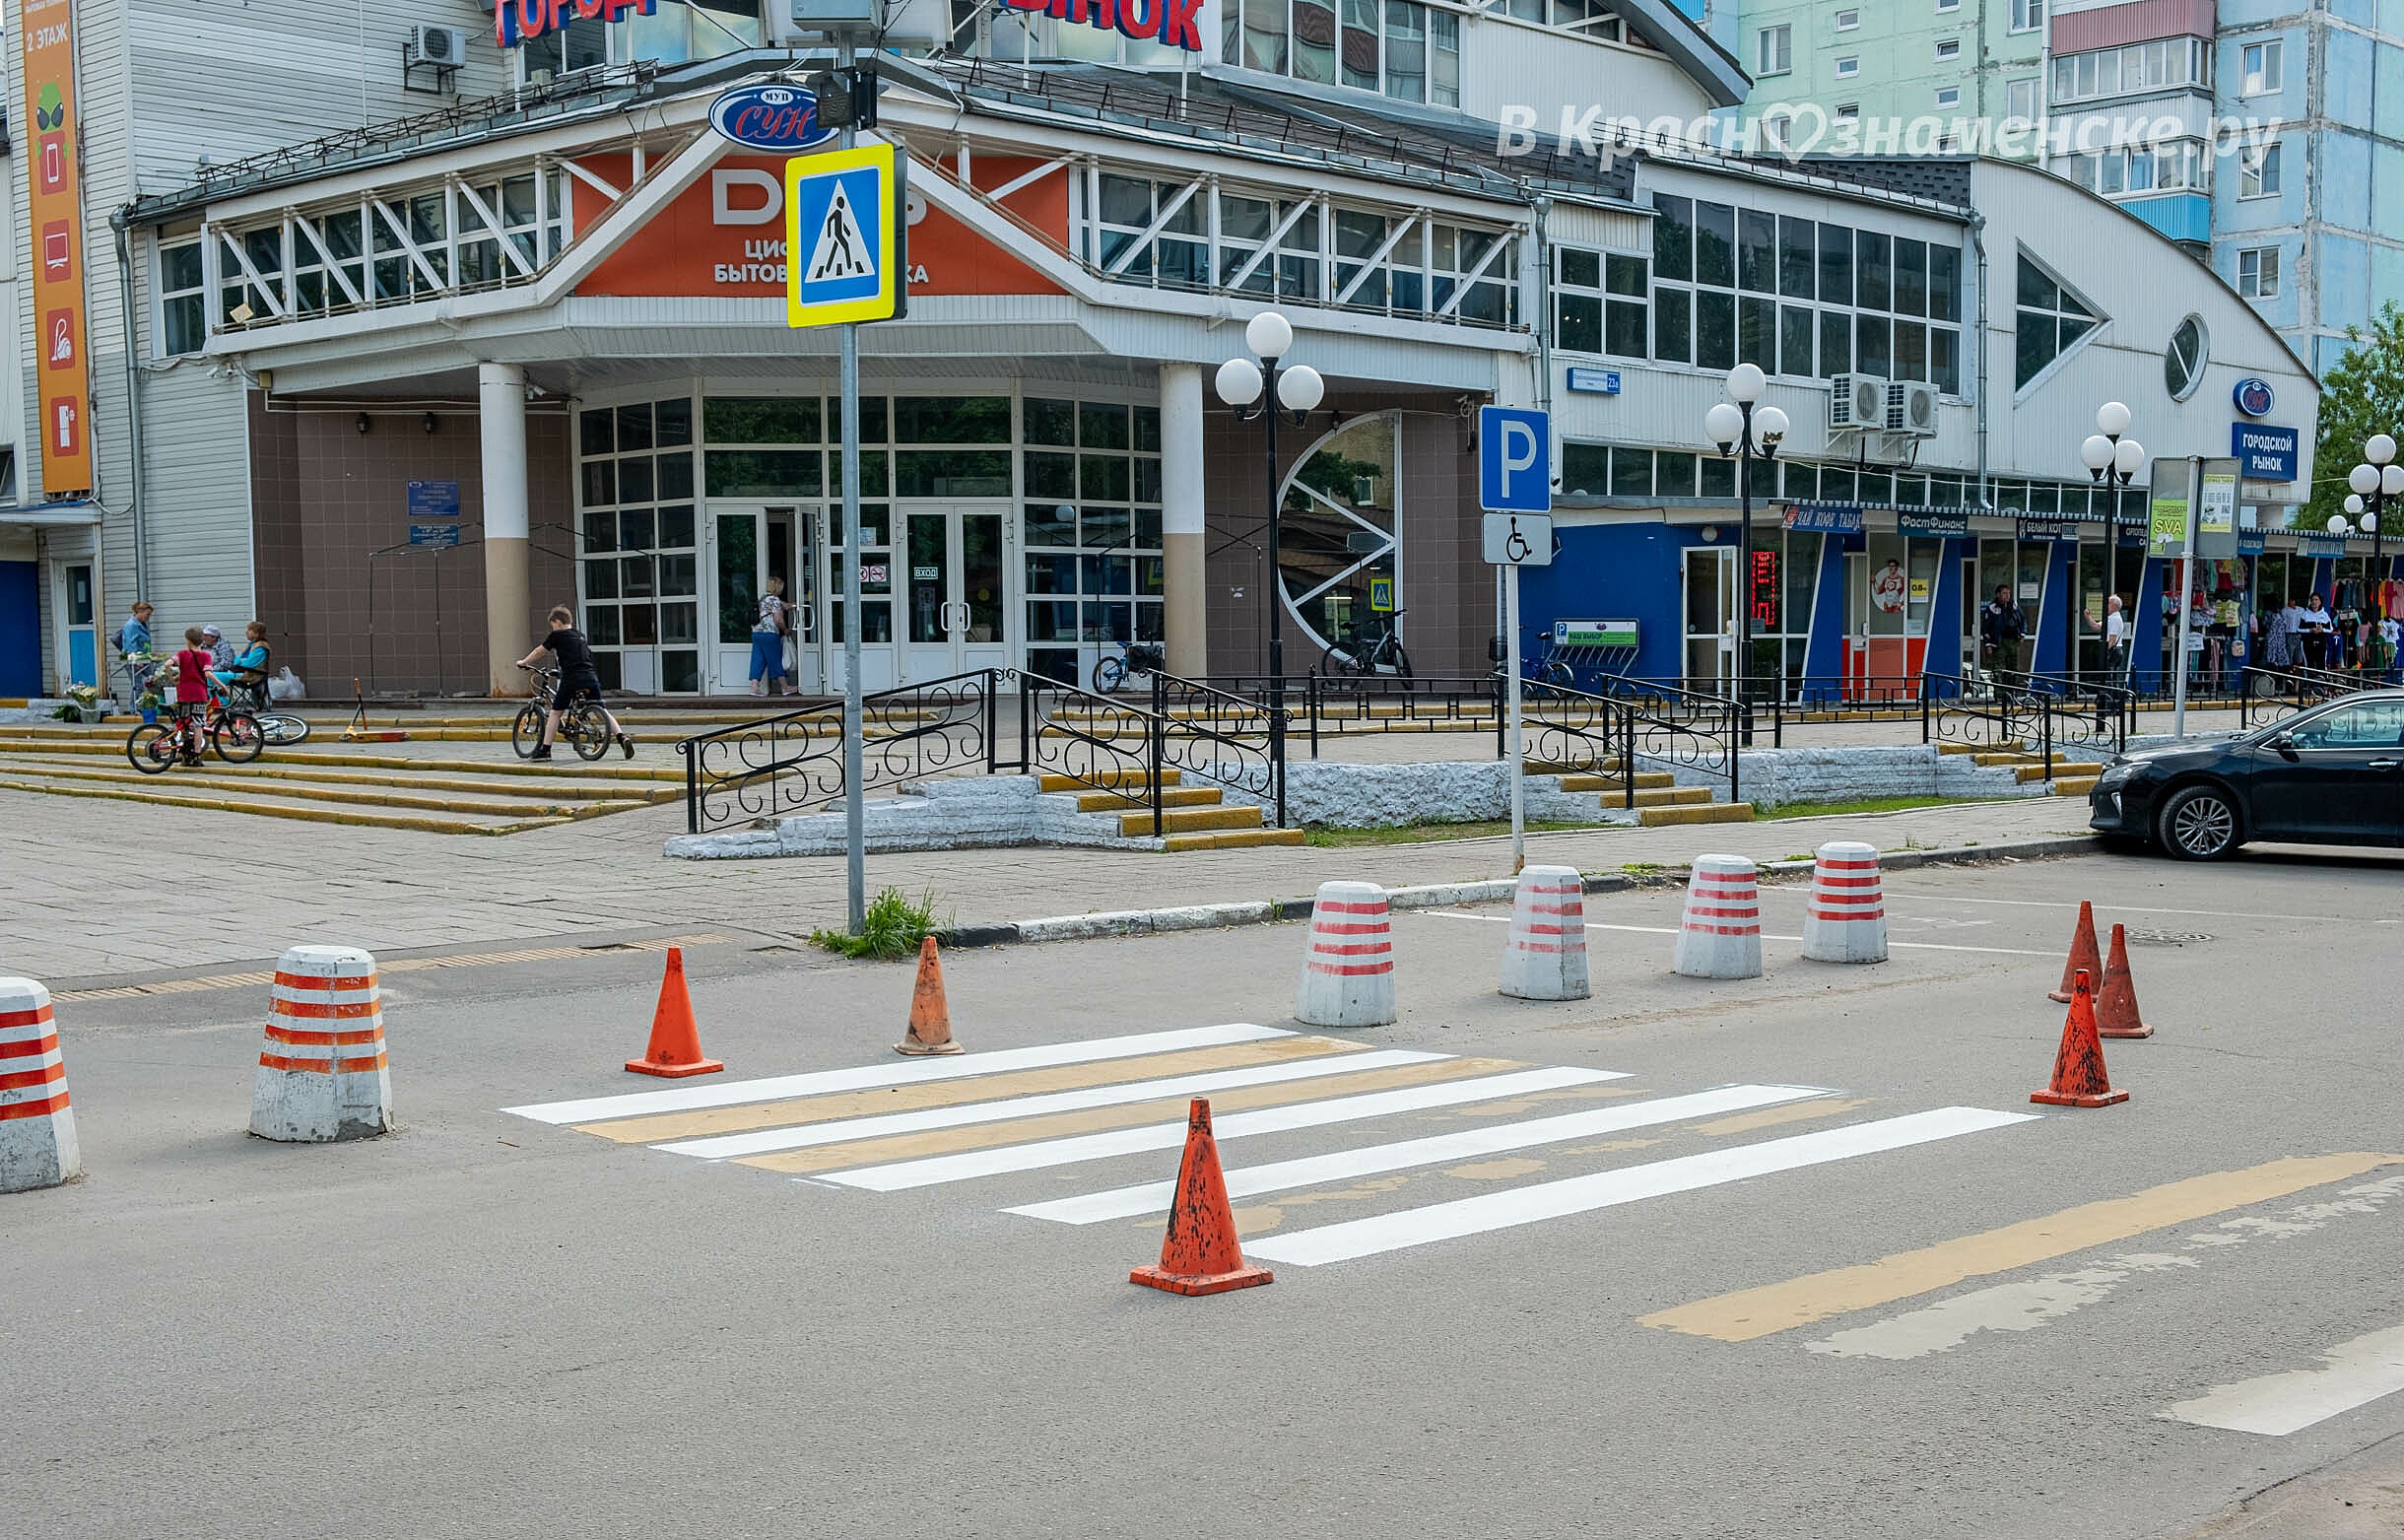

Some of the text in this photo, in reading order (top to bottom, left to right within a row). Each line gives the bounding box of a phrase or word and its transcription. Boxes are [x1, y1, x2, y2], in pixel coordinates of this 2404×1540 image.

[27, 22, 68, 52] 2 ЭТАЖ
[765, 92, 789, 101] МУП
[735, 104, 817, 140] СУН
[714, 264, 787, 283] БЫТОВ
[2242, 434, 2293, 452] ГОРОДСКОЙ
[1501, 420, 1537, 499] P
[2252, 455, 2282, 471] РЫНОК
[1797, 509, 1861, 529] ЧАЙ КОФЕ ТАБАК
[2027, 520, 2047, 533] БЕЛЫЙ
[2048, 523, 2062, 534] КОТ
[2155, 519, 2183, 534] SVA
[915, 569, 938, 577] ВХОД
